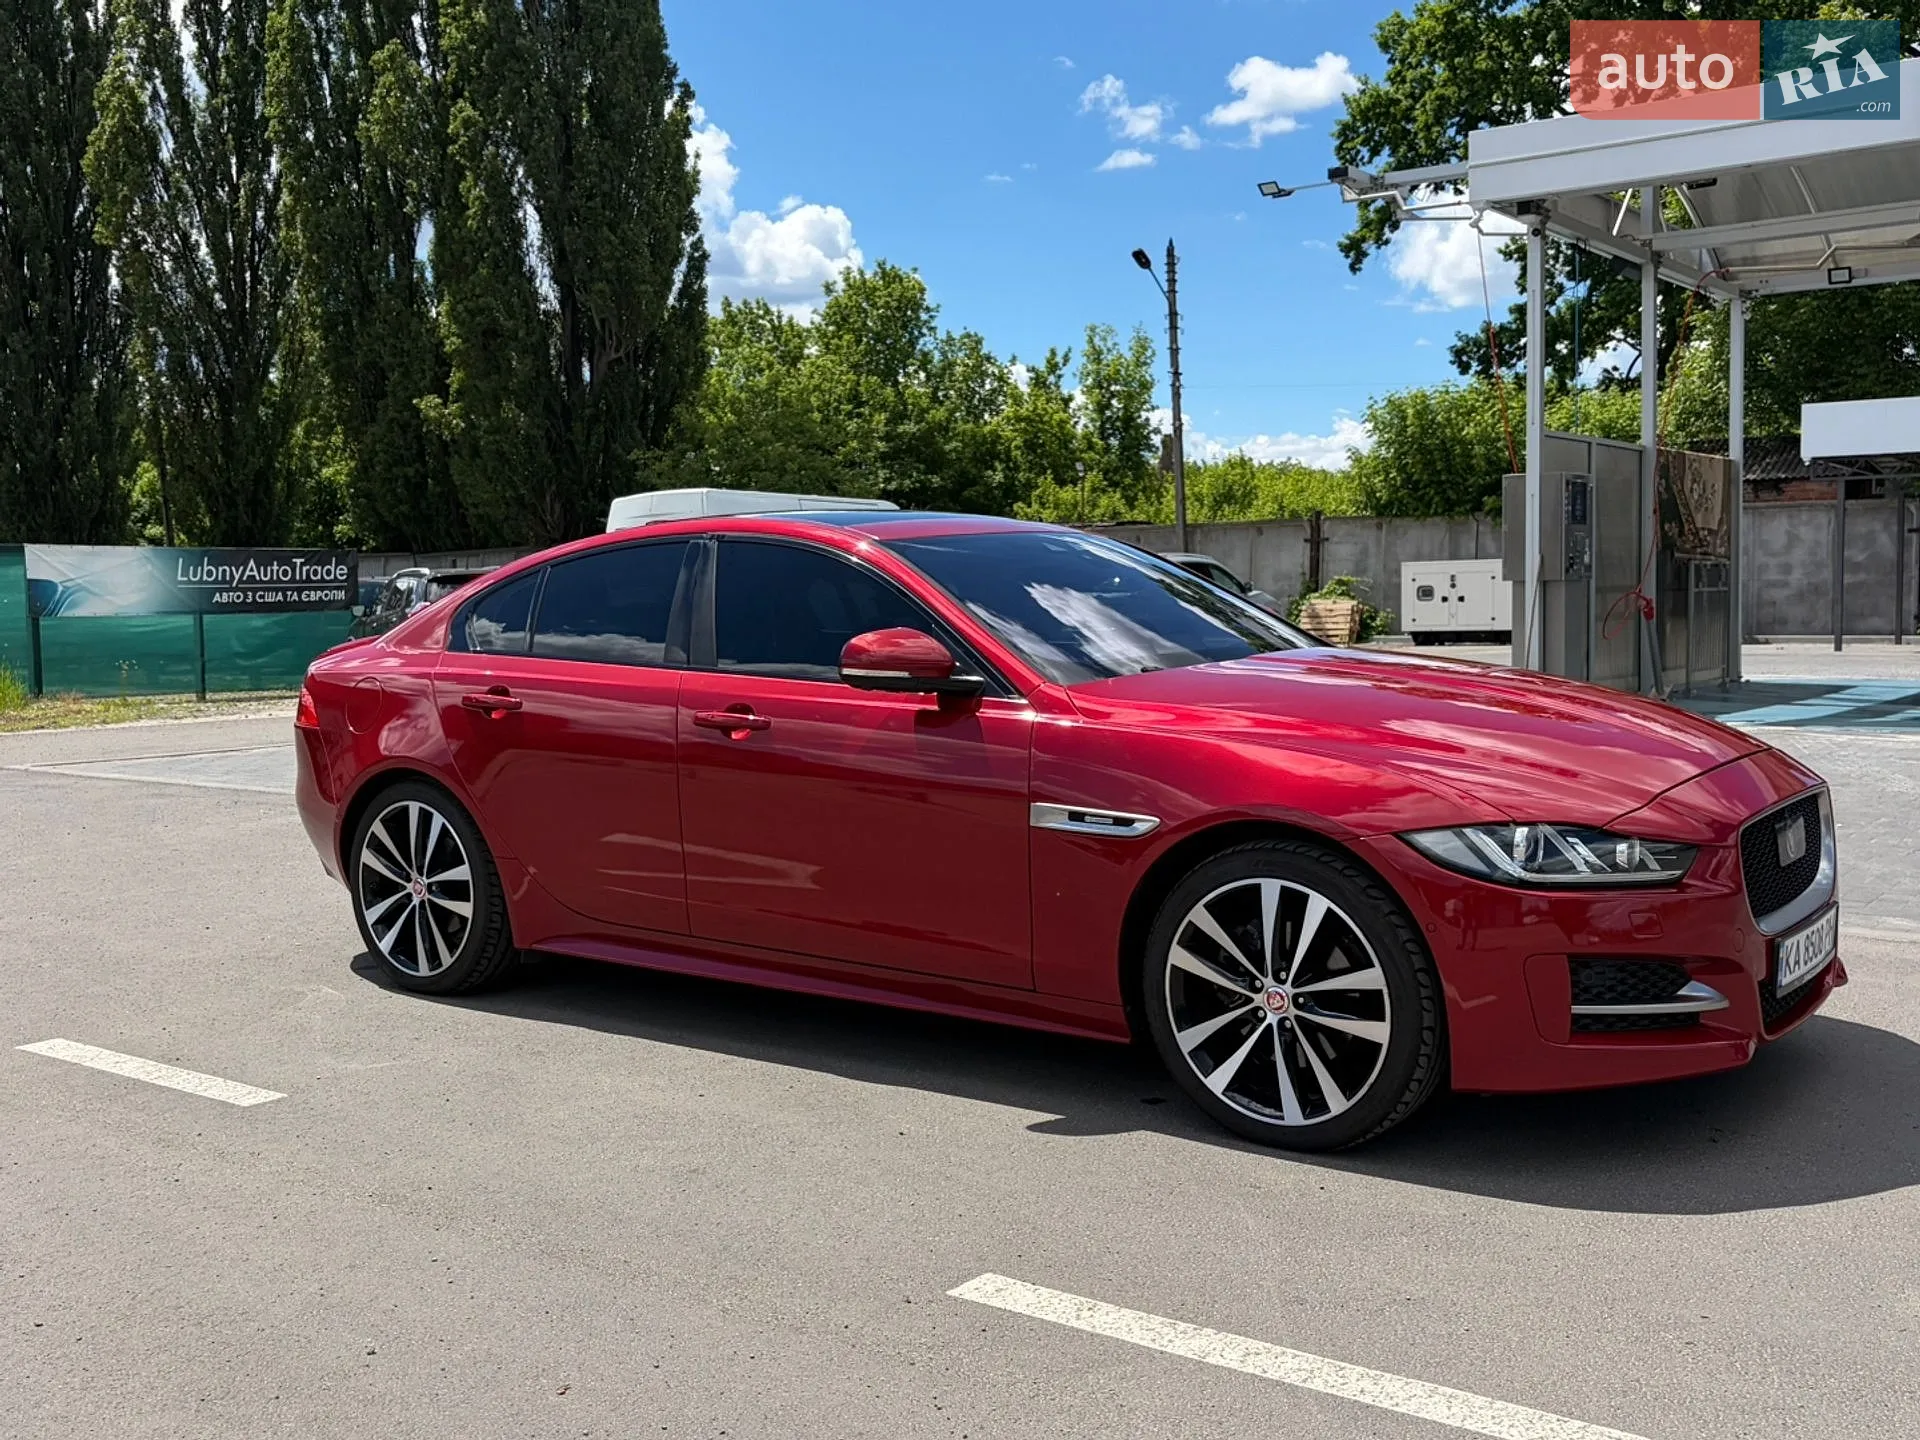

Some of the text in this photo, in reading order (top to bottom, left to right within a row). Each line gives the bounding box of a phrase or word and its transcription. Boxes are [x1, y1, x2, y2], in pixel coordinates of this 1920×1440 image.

[177, 557, 348, 588] LubnyAutoTrade
[212, 591, 244, 603] АВТО
[255, 590, 284, 603] США
[286, 590, 299, 602] ТА
[301, 589, 346, 602] ЄВРОПИ
[1783, 939, 1801, 978] KA
